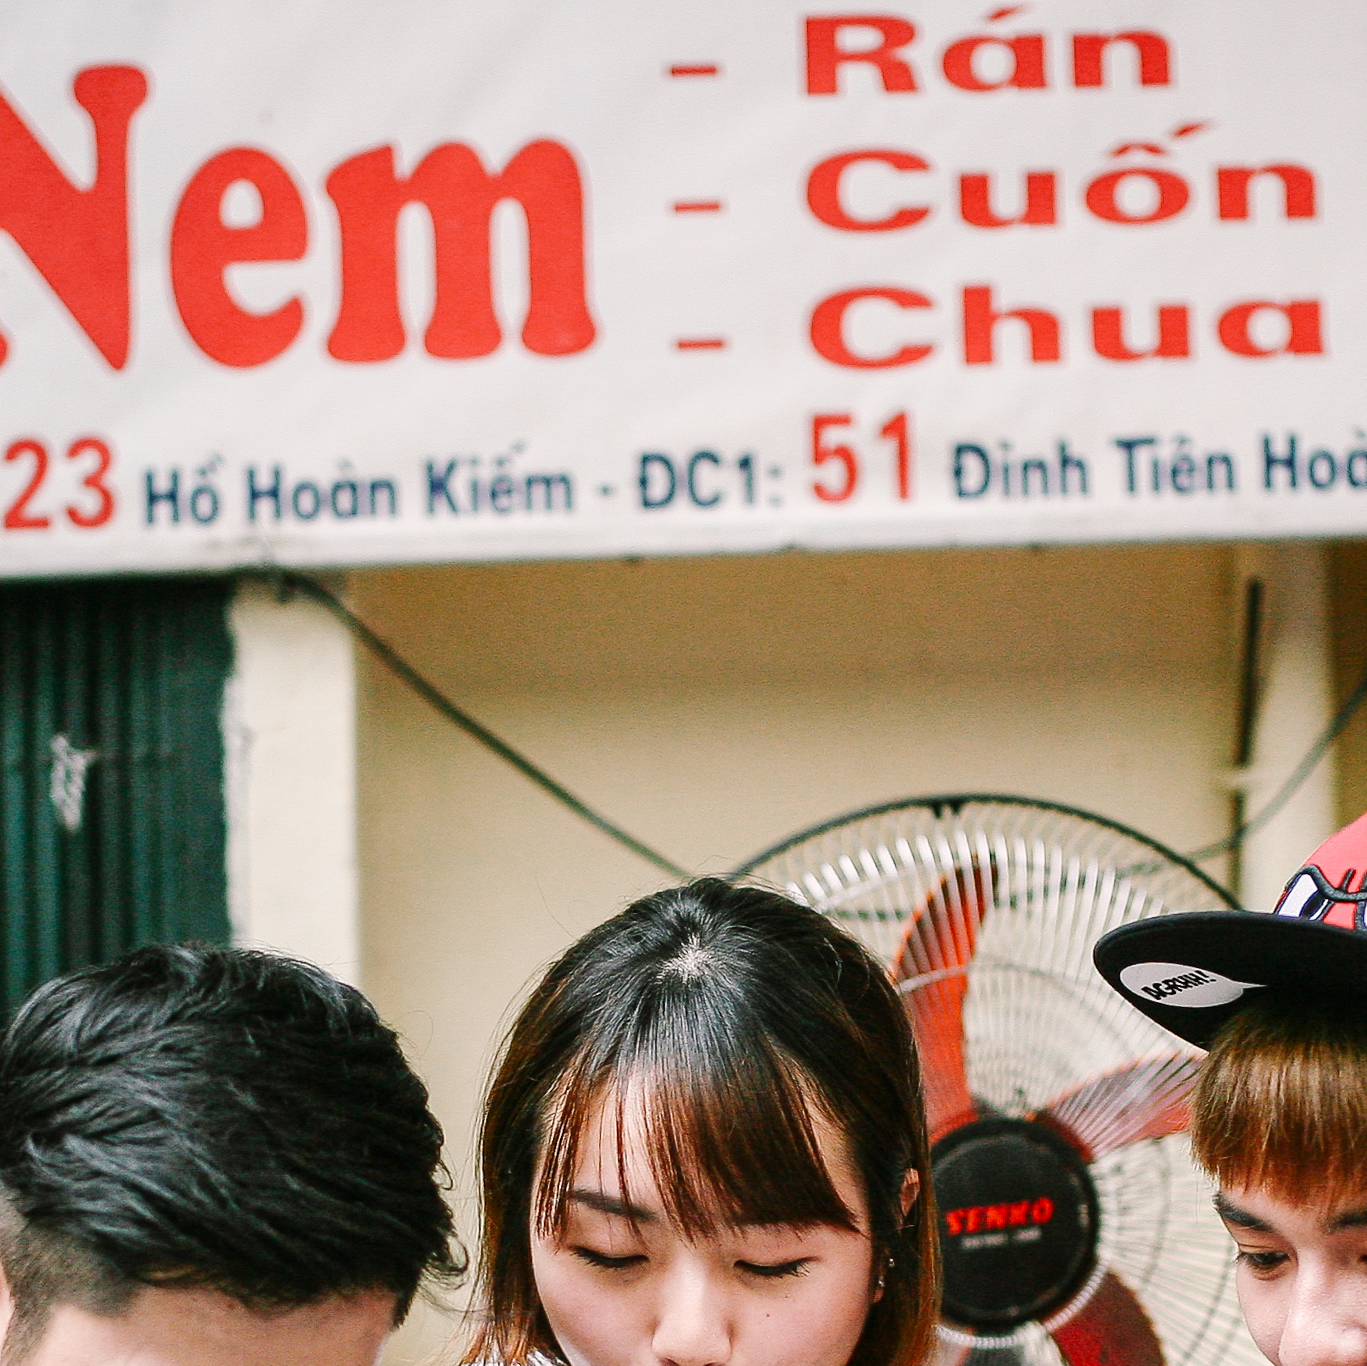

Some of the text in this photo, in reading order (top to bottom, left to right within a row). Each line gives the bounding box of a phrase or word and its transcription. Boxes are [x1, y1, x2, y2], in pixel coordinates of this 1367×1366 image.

[801, 5, 1174, 97] Rán
[803, 120, 1319, 235] Cuốn
[806, 283, 1327, 371] Chua
[1, 435, 117, 533] 23
[143, 453, 225, 528] Hồ
[244, 456, 399, 526] Hoàn
[423, 440, 575, 516] Kiếm
[636, 448, 781, 512] ĐC1:
[809, 410, 914, 505] 51
[949, 438, 1091, 500] Đinh
[1111, 433, 1239, 497] Tiên
